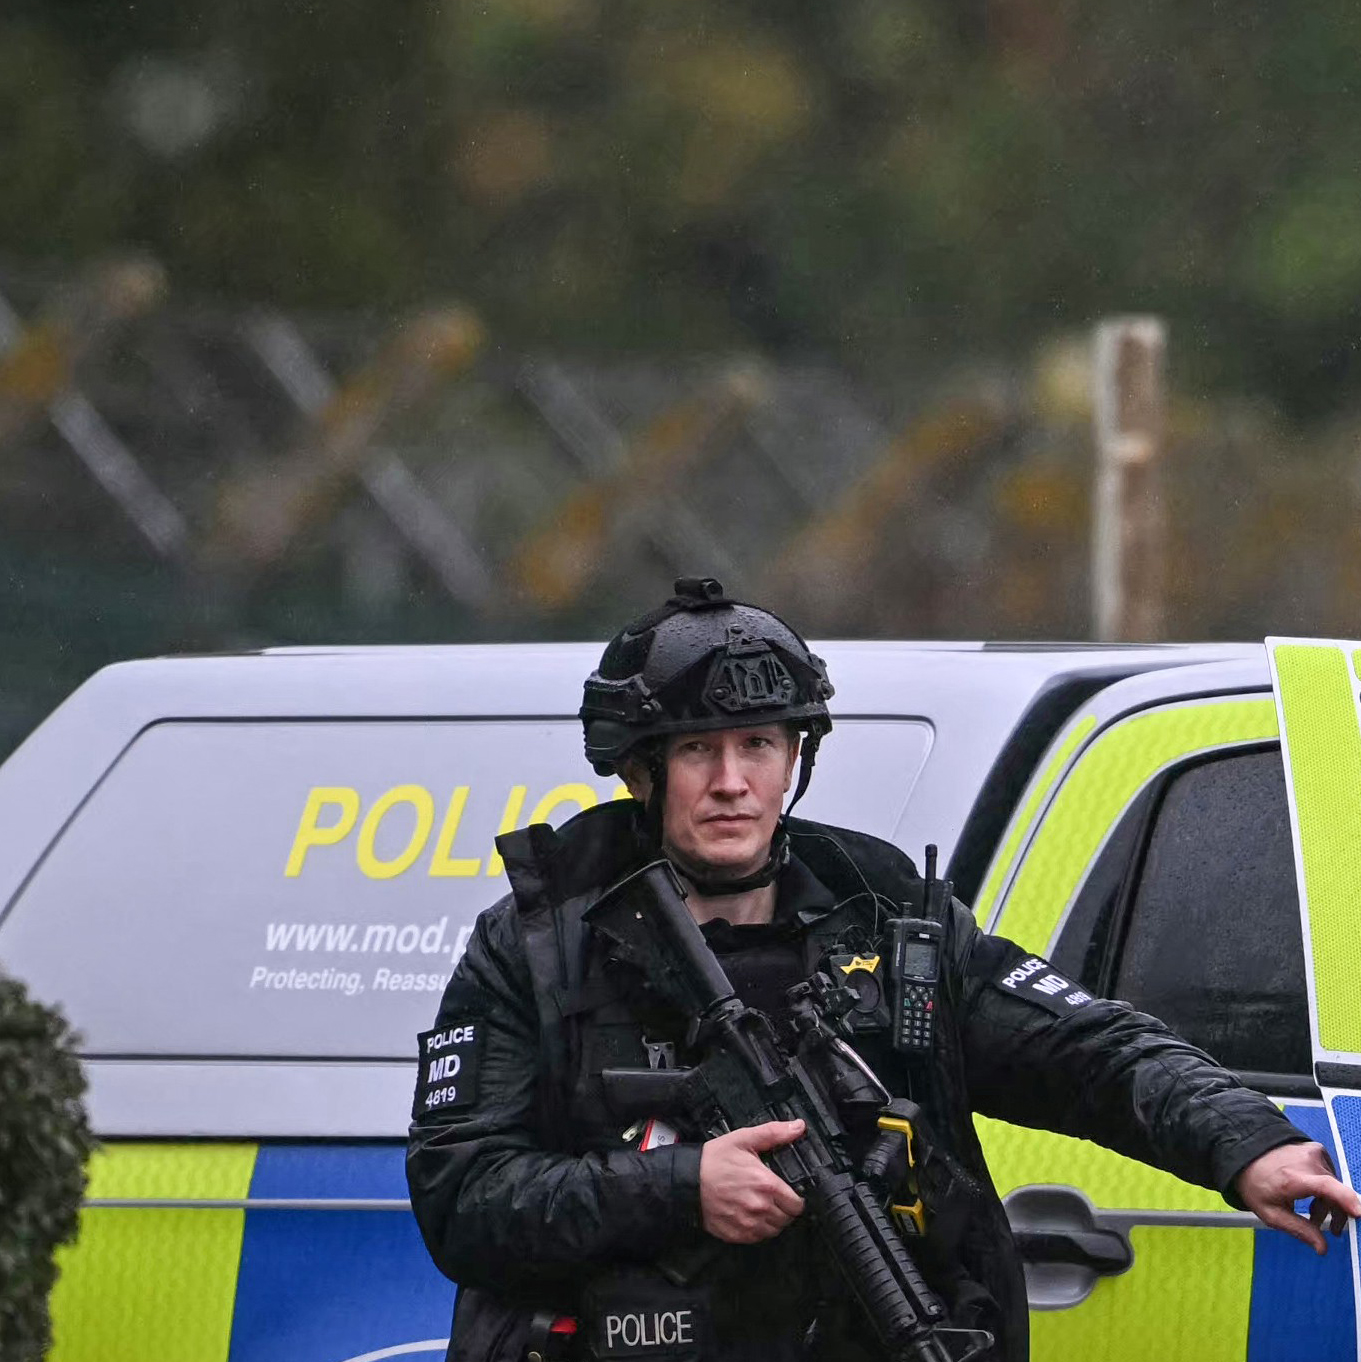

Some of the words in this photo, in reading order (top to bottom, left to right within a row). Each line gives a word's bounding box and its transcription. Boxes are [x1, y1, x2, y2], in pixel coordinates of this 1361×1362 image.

[284, 783, 634, 880] POLI
[249, 966, 366, 996] Protecting,
[1001, 957, 1049, 989] POLICE
[1031, 974, 1070, 996] MD
[426, 1025, 475, 1054] POLICE
[427, 1053, 461, 1083] MD
[424, 1085, 457, 1110] 4819
[605, 1309, 694, 1349] POLICE
